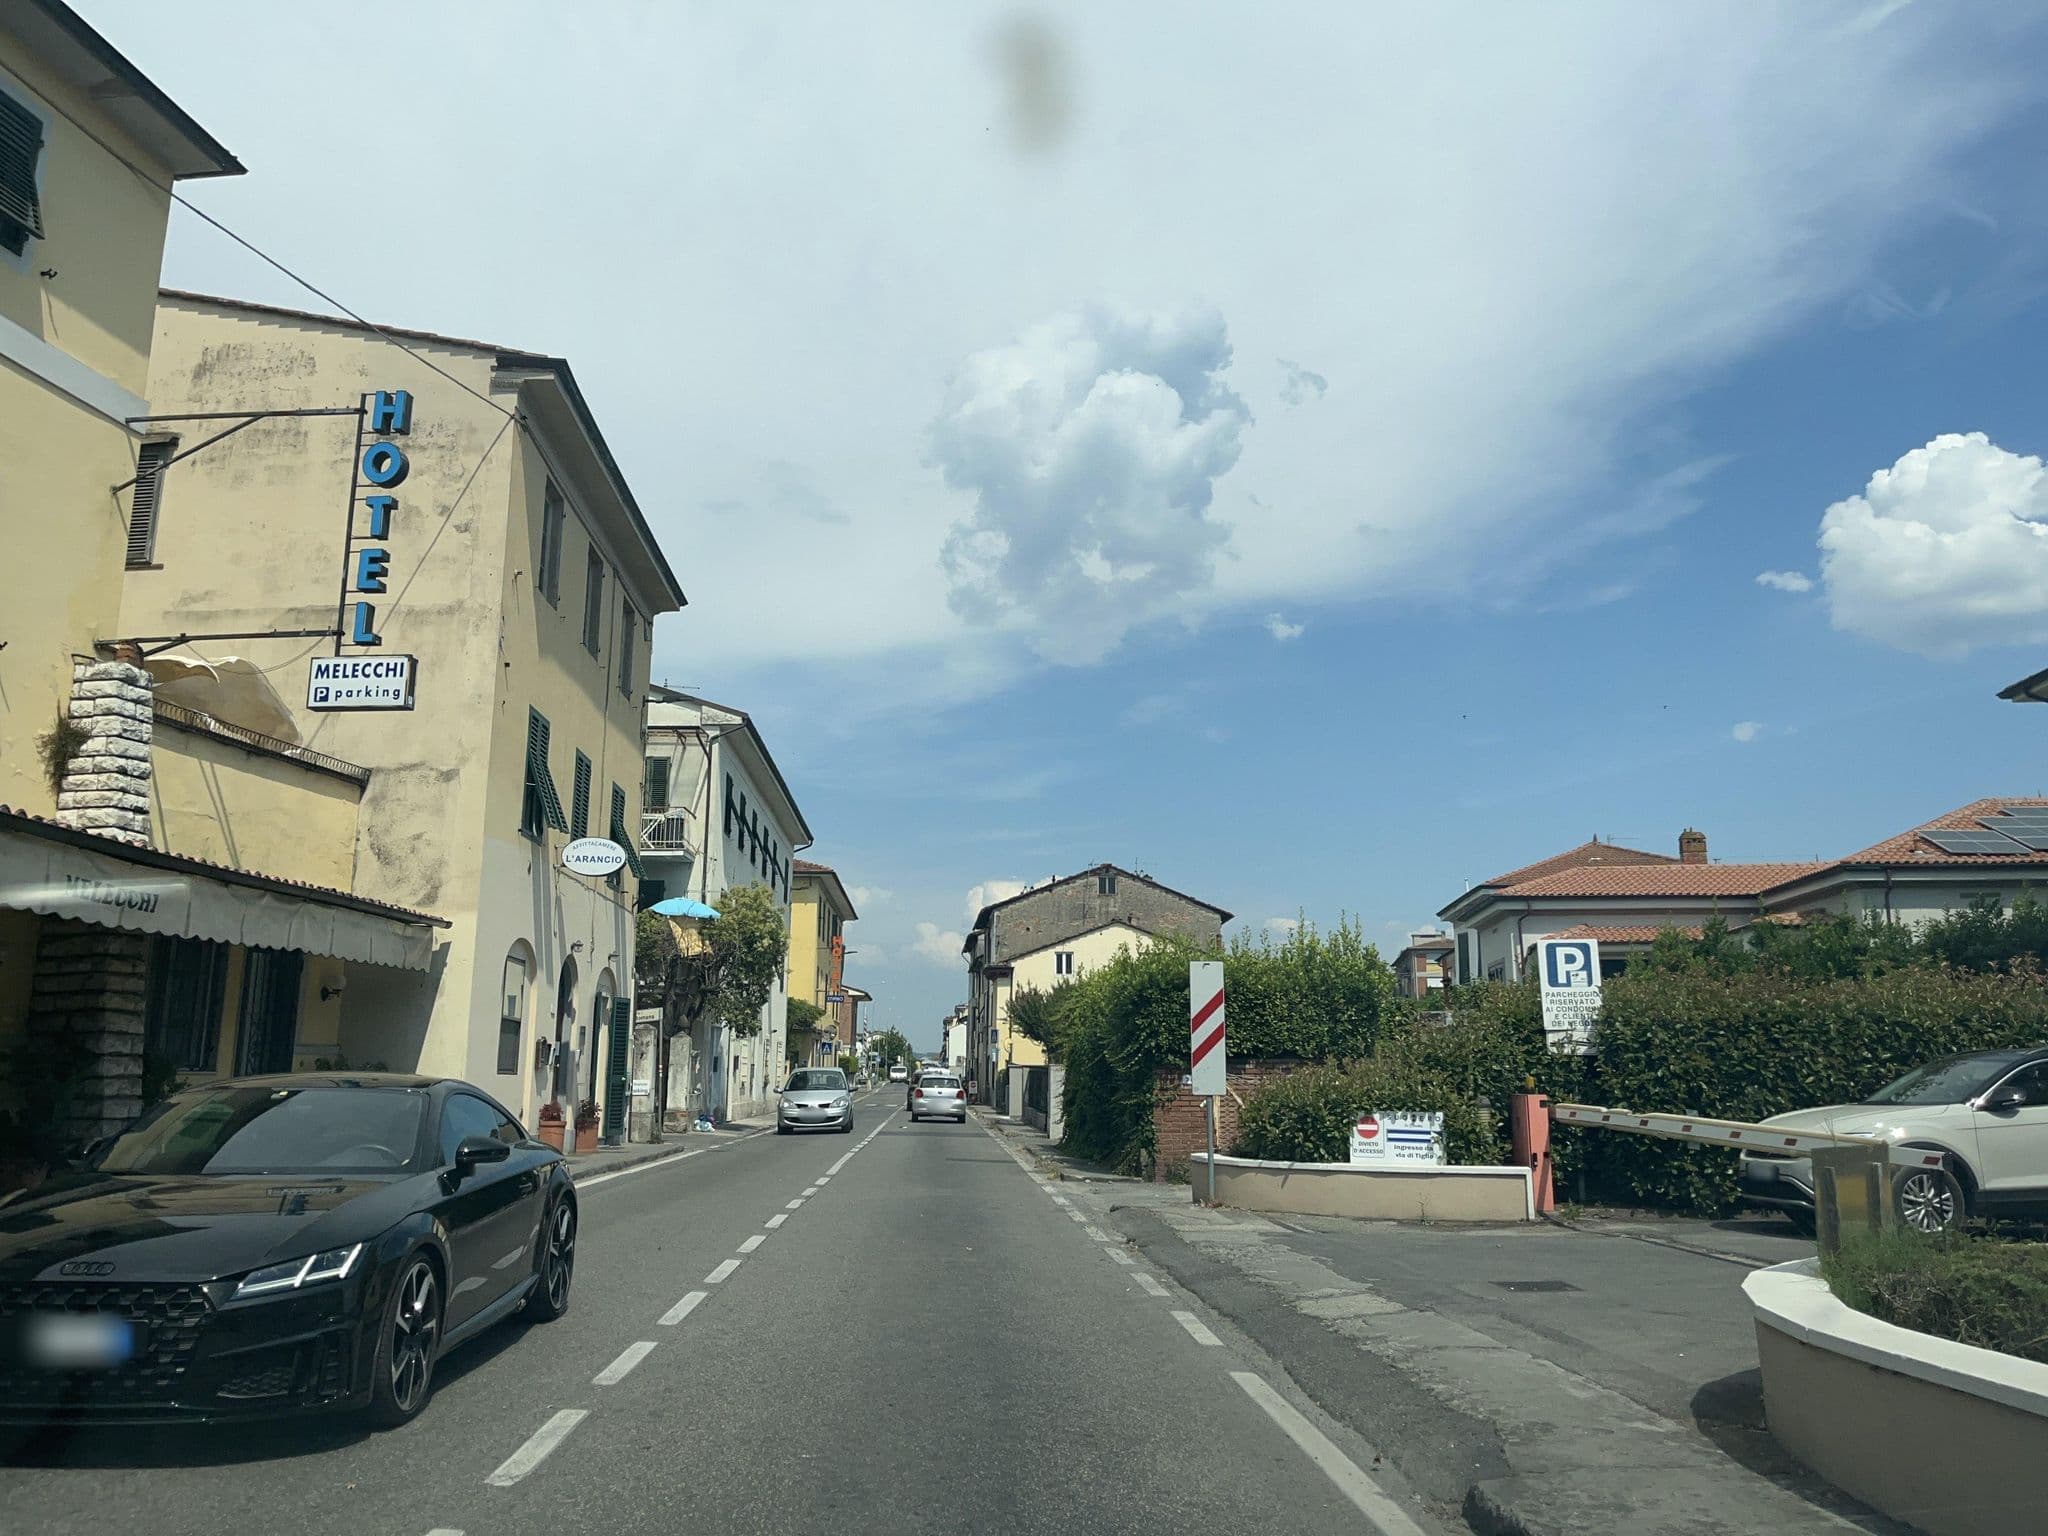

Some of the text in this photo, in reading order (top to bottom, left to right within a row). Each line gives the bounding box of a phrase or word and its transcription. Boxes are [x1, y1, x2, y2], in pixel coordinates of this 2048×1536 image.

[353, 389, 414, 647] HOTEL
[314, 662, 405, 680] MELECCHI
[315, 685, 401, 702] P parking
[565, 855, 622, 864] L'ARANCIO
[1555, 946, 1585, 984] P
[1556, 1005, 1599, 1013] CONDOMN
